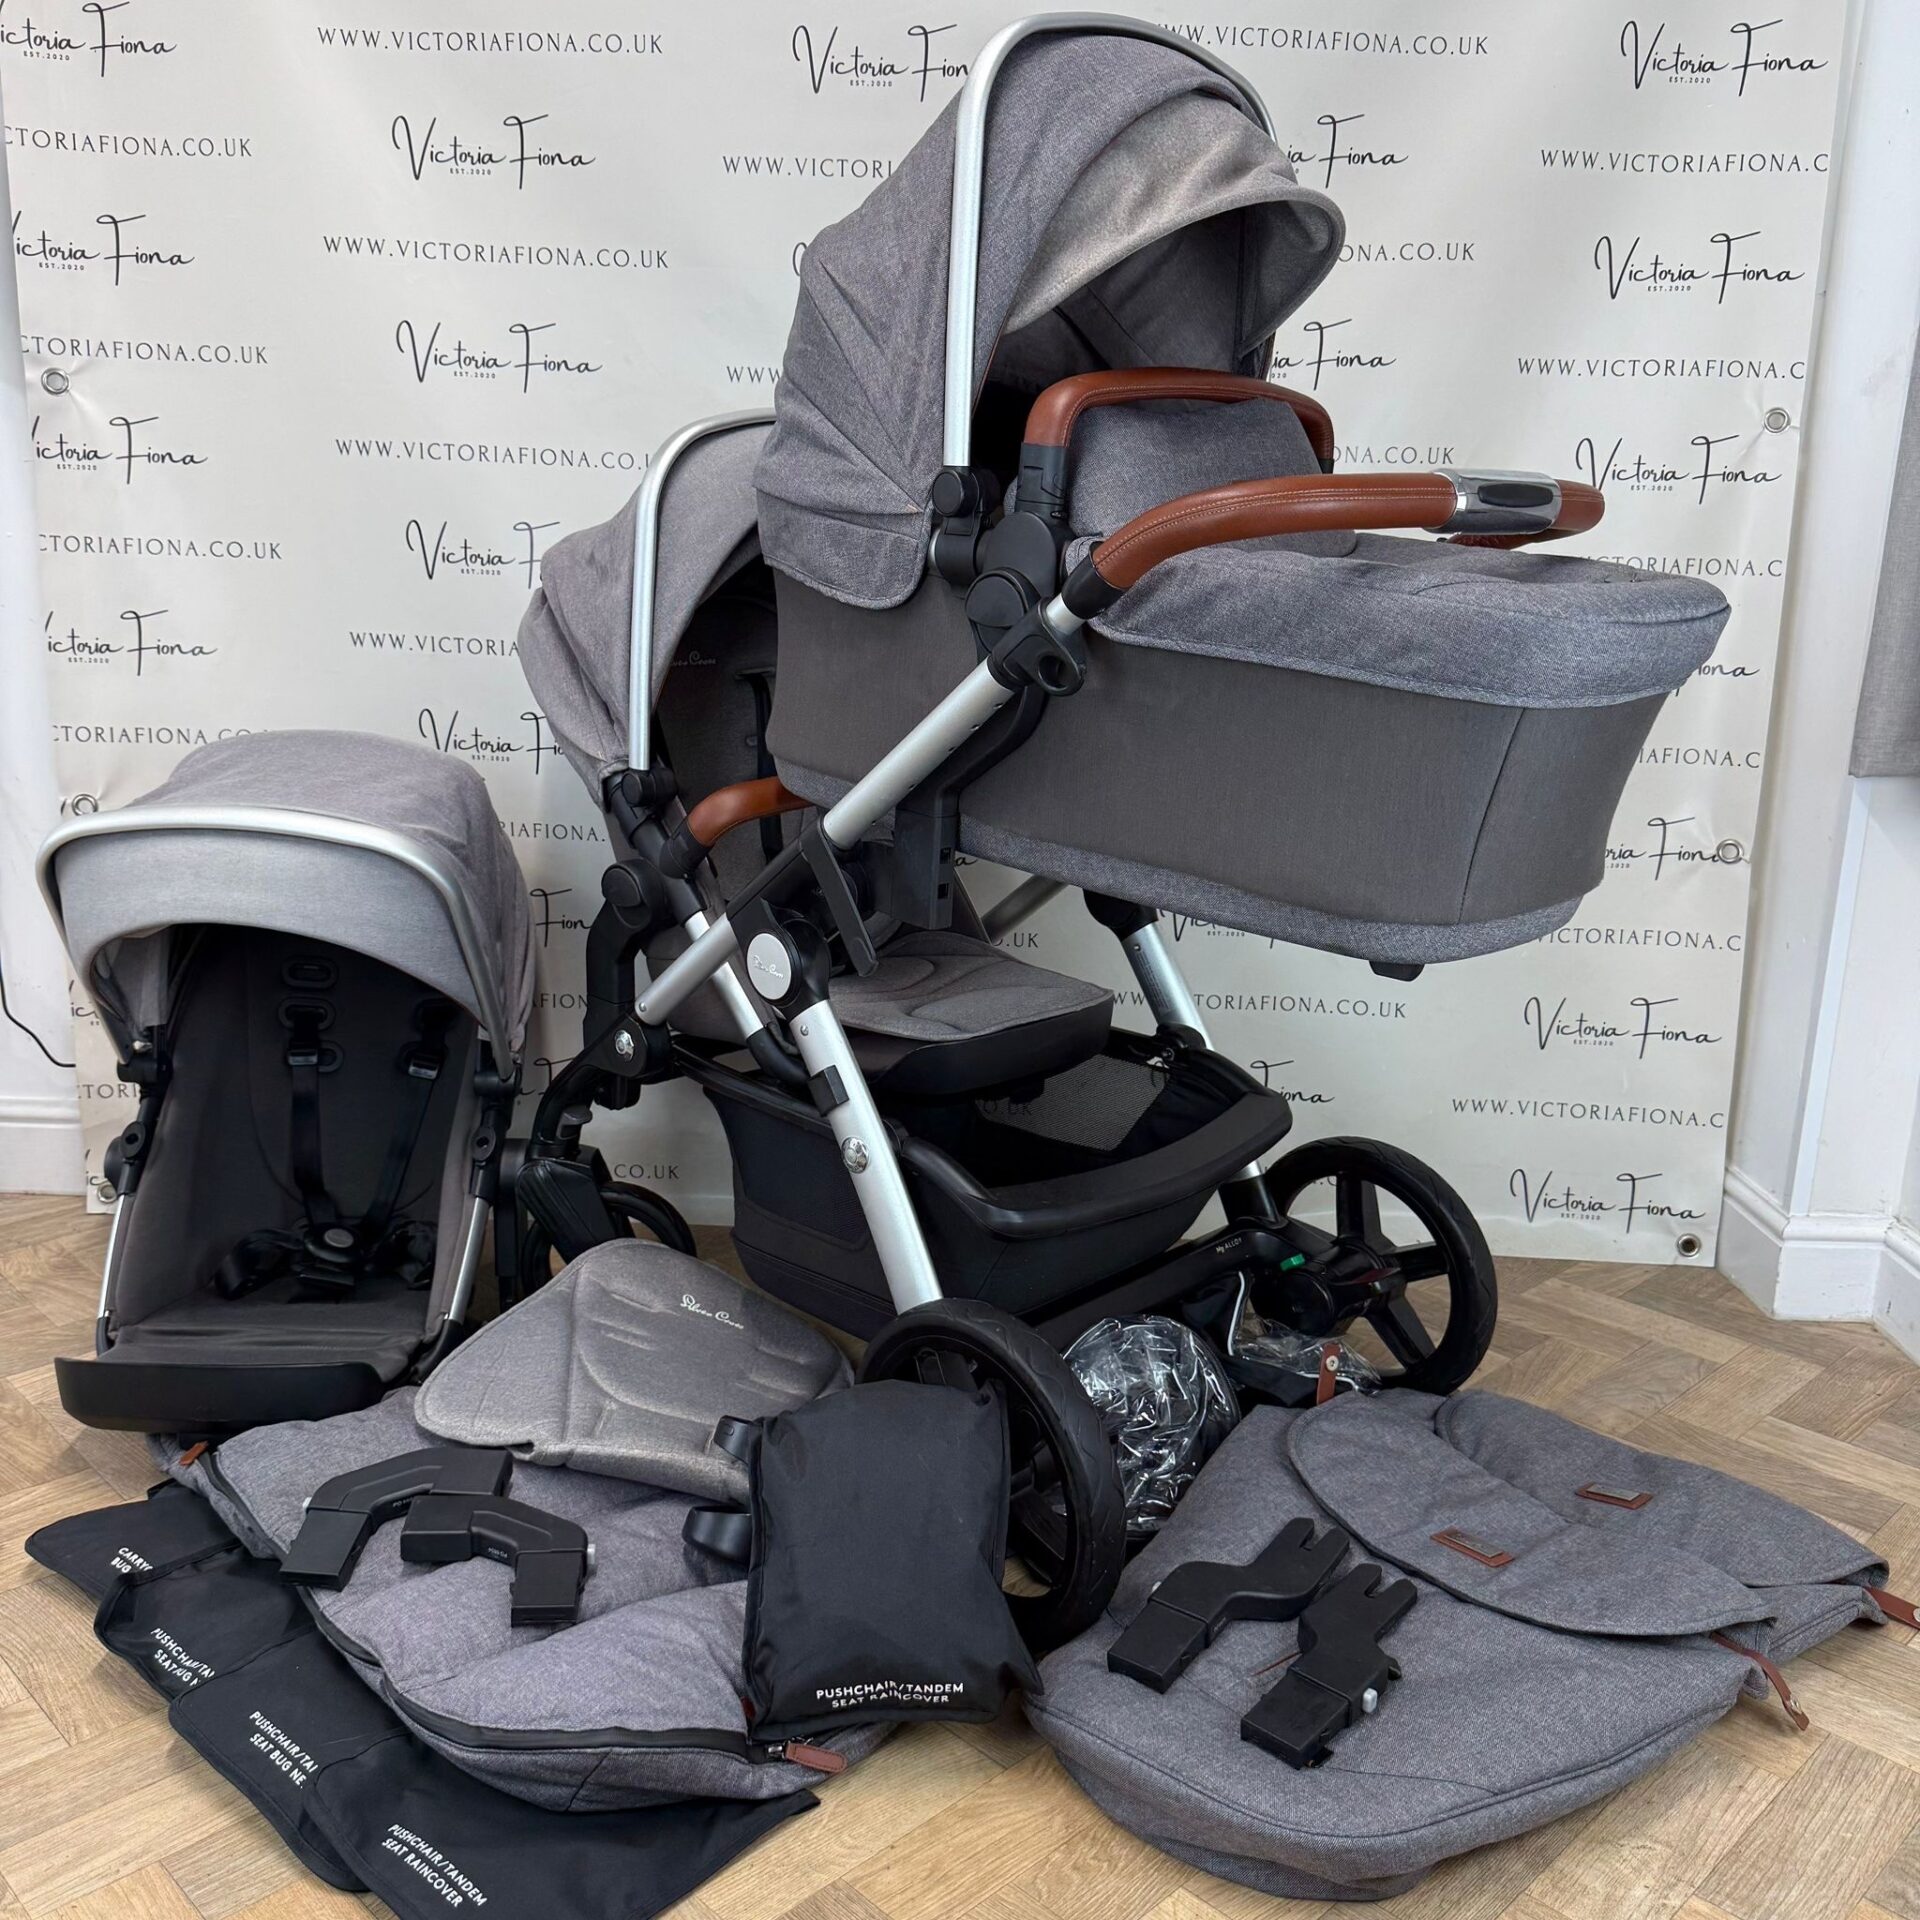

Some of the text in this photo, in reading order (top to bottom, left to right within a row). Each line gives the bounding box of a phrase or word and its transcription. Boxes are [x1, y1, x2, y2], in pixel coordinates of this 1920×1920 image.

[0, 0, 177, 77] ictoria Fiona
[23, 50, 70, 61] EST.2020
[317, 27, 664, 54] WWW.VICTORIAFIONA.CO.UK
[793, 24, 969, 102] Victoria Fion
[1164, 24, 1488, 55] W.VICTORIAFIONA.CO.UK
[1620, 19, 1829, 97] Victoria Fiona
[1669, 76, 1712, 84] EST.2020
[392, 114, 597, 190] Victoria Fiona
[449, 167, 492, 176] EST.2020
[1317, 114, 1409, 189] Fiona
[1541, 149, 1829, 173] WWW.VICTORIAFIONA.C
[12, 210, 195, 286] ictoria Fiona
[323, 236, 669, 269] WWW.VICTORIAFIONA.CO.UK
[1594, 231, 1805, 304] Victoria Fiona
[396, 320, 603, 393] Victoria Fiona
[453, 370, 496, 379] EST.2020
[1303, 318, 1397, 391] Fiona
[1518, 358, 1806, 380] WWW.VICTORIAFIONA.C
[32, 416, 208, 484] ictoria Fiona
[335, 439, 649, 470] WWW.VICTORIAFIONA.CO.
[1576, 434, 1783, 505] Victoria Fiona
[406, 520, 516, 580] Victoria
[45, 609, 218, 676] ictoria Fiona
[418, 708, 524, 753] Victoria
[1648, 816, 1720, 881] Fion
[530, 888, 592, 947] Fion
[1524, 997, 1722, 1060] Victoria Fiona
[1453, 1098, 1723, 1128] WWW.VICTORIAFIONA.C
[1510, 1168, 1706, 1234] Victoria Fiona
[816, 1680, 964, 1700] PUSHCHAIR/TANDEM
[831, 1689, 949, 1708] SEAT RAINCOVER
[249, 1733, 307, 1787] SEAT BUG NE
[381, 1838, 463, 1908] SEAT RAINCOVER
[387, 1824, 488, 1907] PUSHCHAIR/TANDEM
